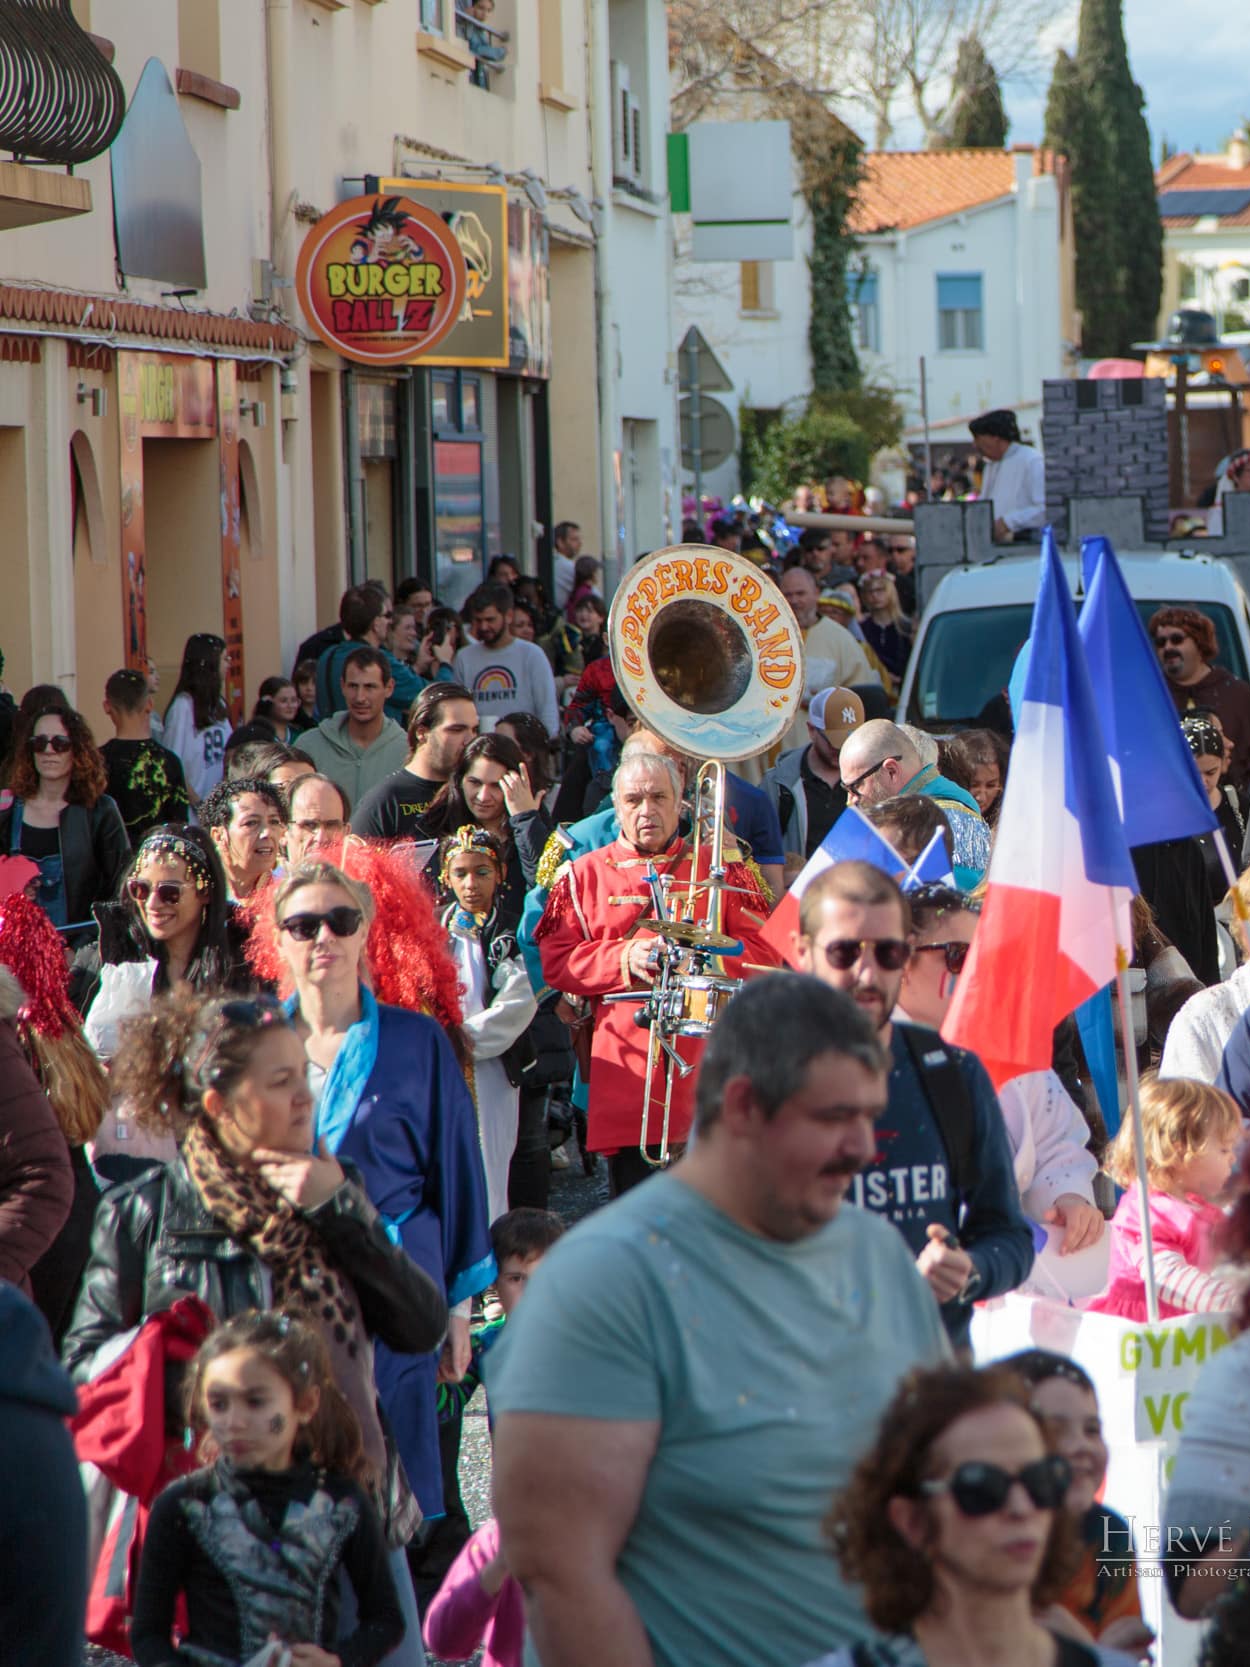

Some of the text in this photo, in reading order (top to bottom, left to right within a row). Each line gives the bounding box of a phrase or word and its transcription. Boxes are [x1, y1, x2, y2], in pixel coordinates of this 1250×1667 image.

[327, 263, 444, 297] BURGER
[332, 299, 436, 333] BALL Z
[731, 575, 797, 690] BAND
[400, 801, 430, 816] DREA
[853, 1164, 947, 1209] ISTER
[1120, 1322, 1240, 1372] GYMN
